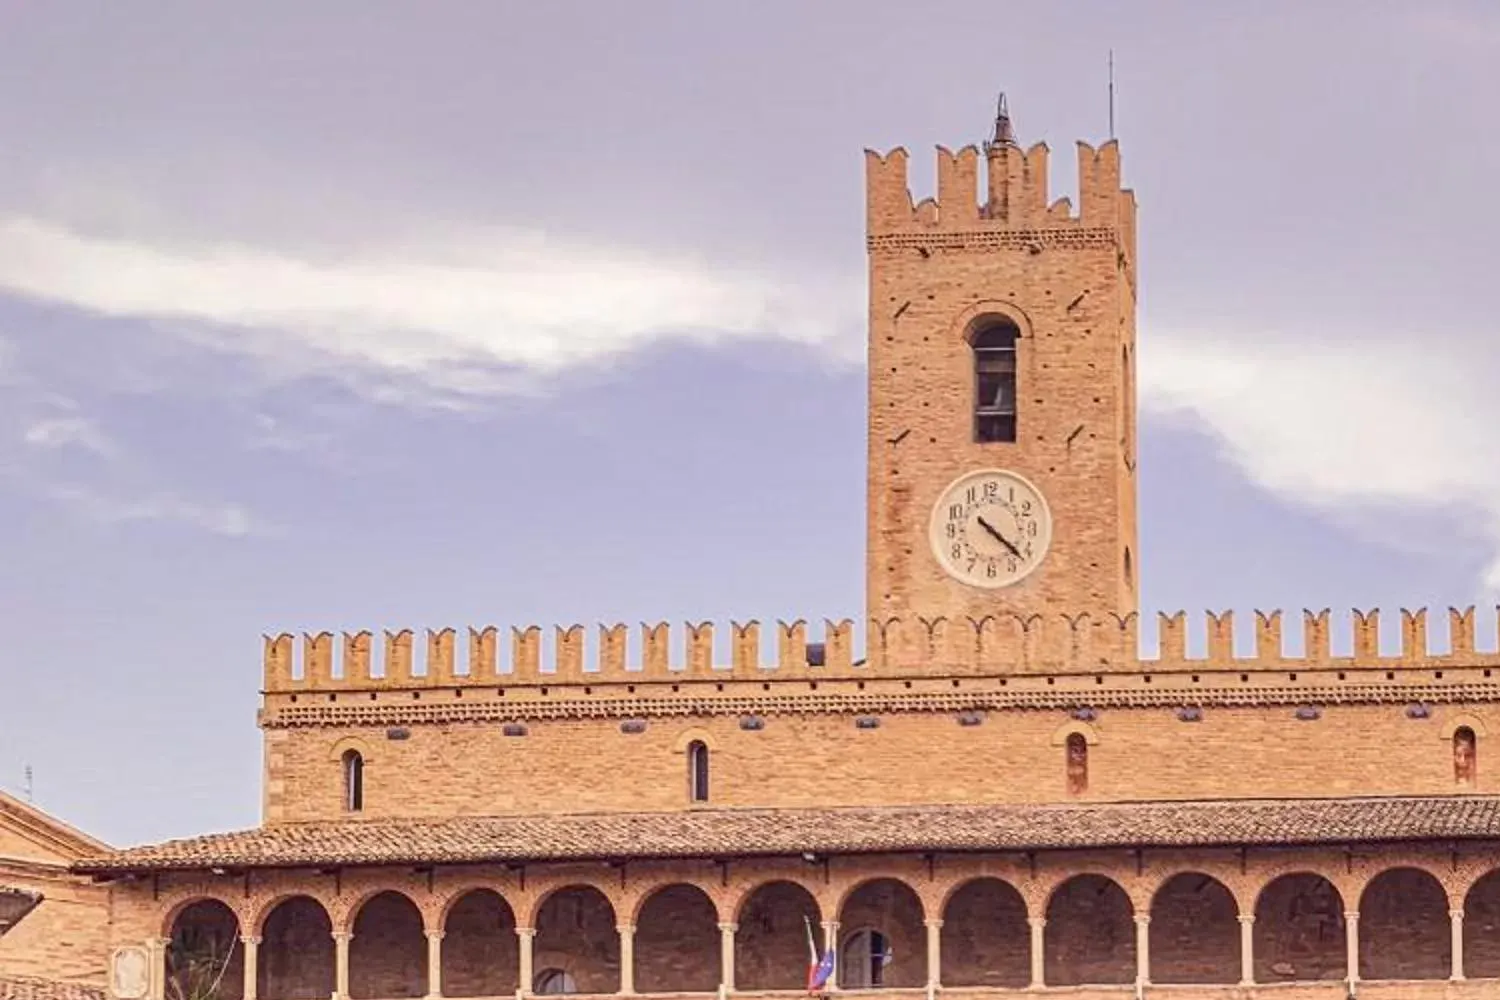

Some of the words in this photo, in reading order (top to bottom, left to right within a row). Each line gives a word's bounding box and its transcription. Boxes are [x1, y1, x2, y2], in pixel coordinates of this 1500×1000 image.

[966, 486, 976, 505] 11
[983, 480, 999, 498] 12
[1008, 486, 1015, 503] 1
[949, 503, 963, 521] 10
[1021, 500, 1032, 518] 2
[946, 522, 956, 539] 9
[1027, 520, 1038, 537] 3
[951, 542, 962, 560] 8
[1022, 541, 1033, 558] 4
[966, 556, 977, 576] 7
[986, 562, 997, 579] 6
[1007, 556, 1018, 574] 5
